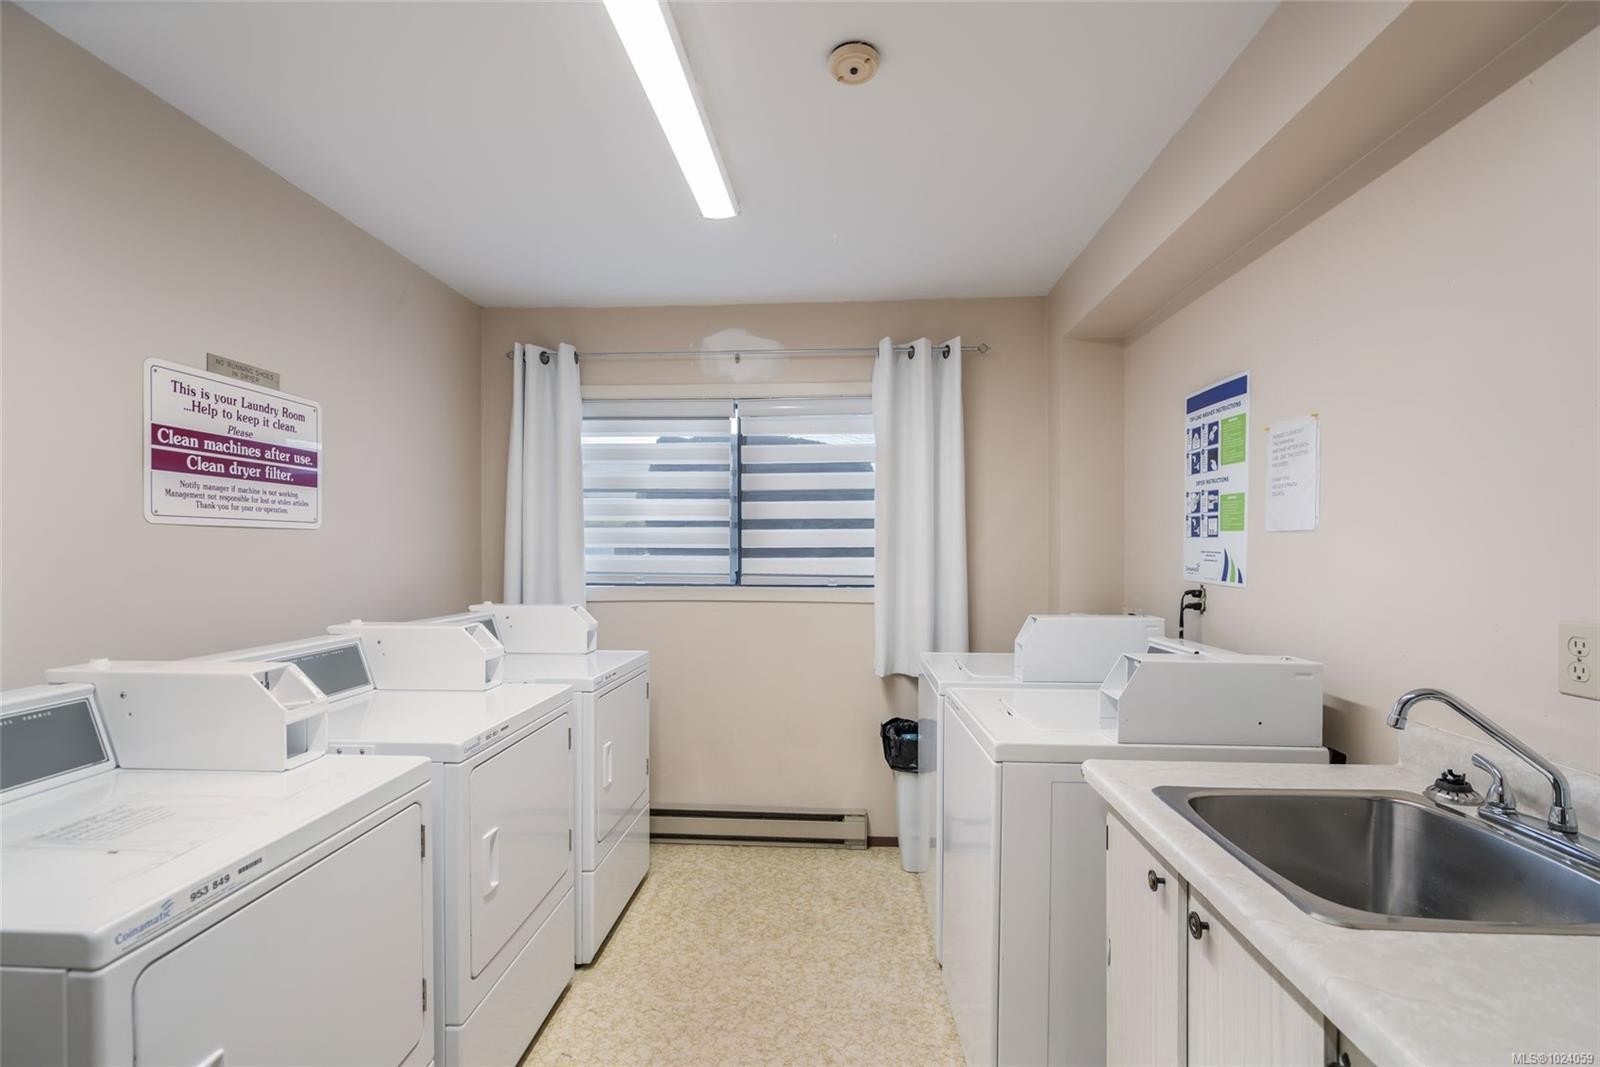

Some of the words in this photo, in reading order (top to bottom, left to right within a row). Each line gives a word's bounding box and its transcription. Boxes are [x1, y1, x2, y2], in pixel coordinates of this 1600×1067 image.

[216, 358, 224, 366] NO
[227, 361, 253, 374] RUNNING
[255, 368, 274, 380] SHOES
[170, 380, 197, 397] This
[201, 388, 210, 400] is
[214, 393, 237, 406] your
[242, 397, 279, 418] Laundry
[282, 407, 306, 422] Room
[183, 400, 218, 419] ...Help
[222, 408, 232, 420] to
[236, 411, 260, 427] keep
[263, 416, 269, 427] it
[272, 418, 297, 434] clean.
[227, 425, 254, 438] Please
[157, 428, 199, 448] Clean
[204, 439, 261, 458] machines
[264, 447, 291, 462] after
[294, 454, 313, 466] use.
[186, 455, 225, 473] Clean
[229, 459, 261, 479] dryer
[265, 467, 294, 482] filter.
[164, 488, 205, 501] Management
[207, 493, 217, 501] not
[219, 494, 249, 504] responsible
[260, 496, 269, 504] lost
[180, 480, 200, 490] Notify
[203, 484, 229, 493] manager
[231, 483, 235, 492] if
[238, 486, 260, 494] machine
[262, 487, 267, 495] is
[268, 488, 277, 496] not
[241, 505, 253, 513] your
[189, 885, 209, 902] 953
[212, 874, 230, 889] 849
[114, 909, 171, 945] Coinamatic
